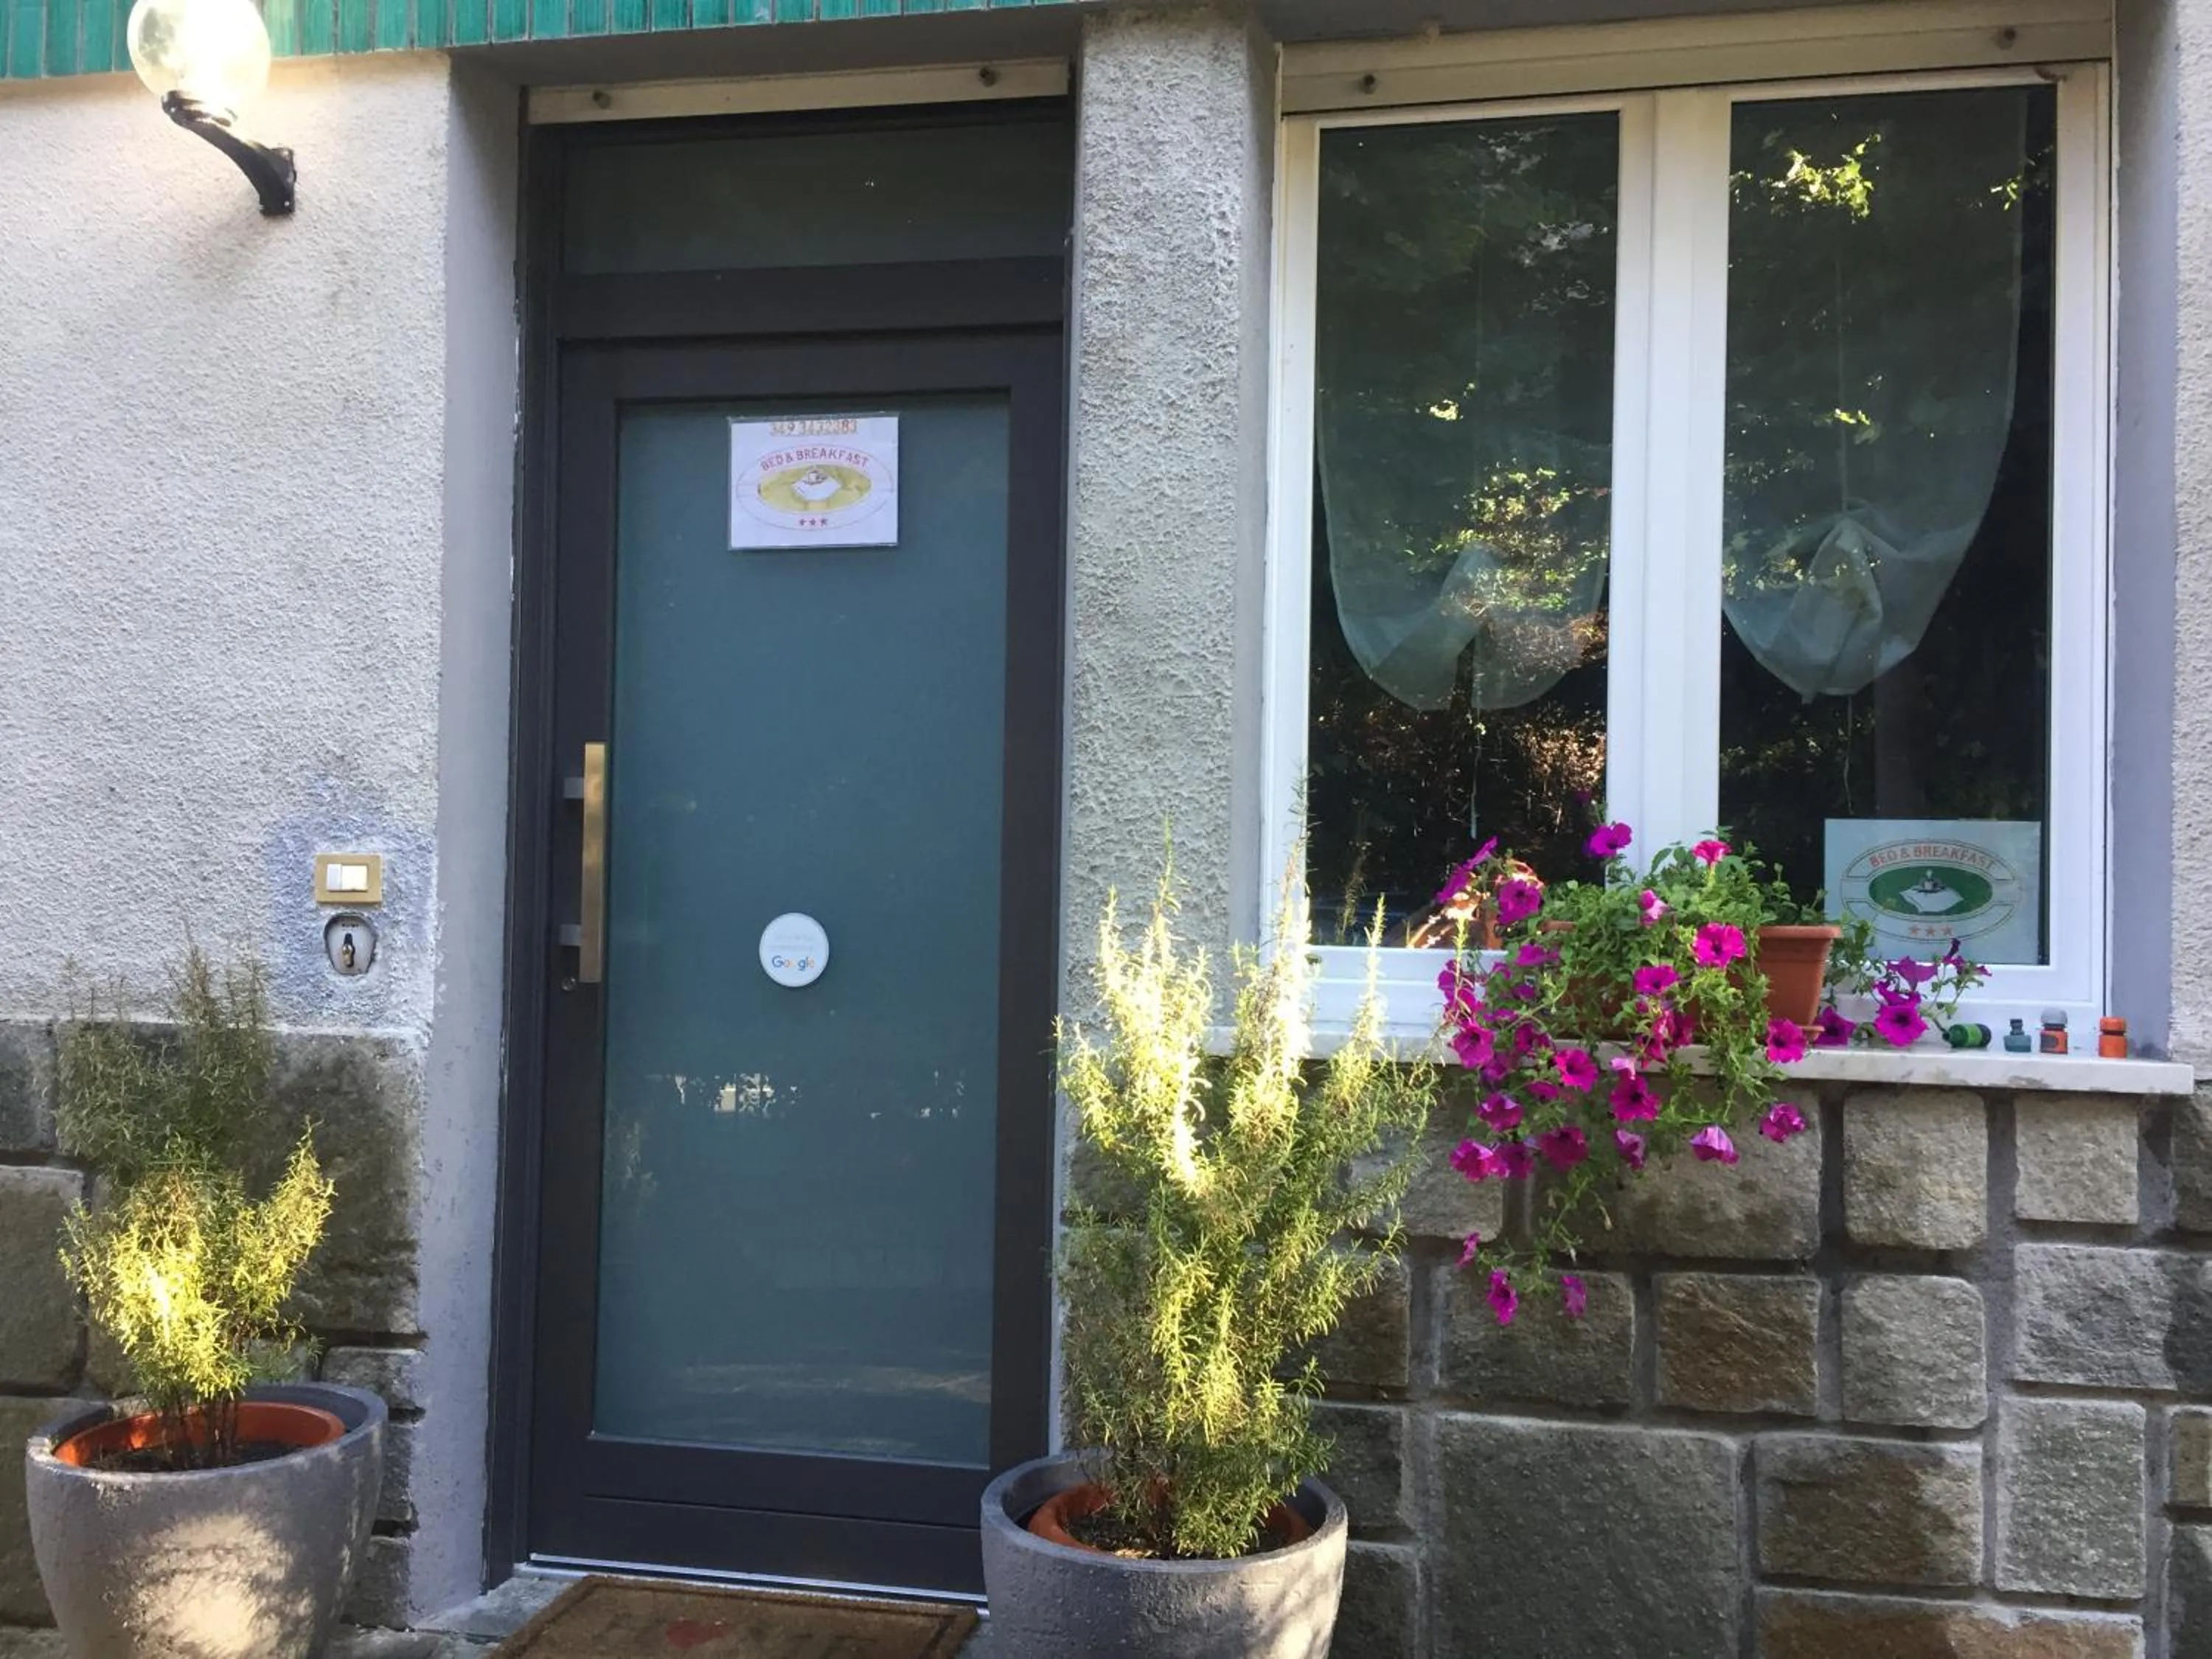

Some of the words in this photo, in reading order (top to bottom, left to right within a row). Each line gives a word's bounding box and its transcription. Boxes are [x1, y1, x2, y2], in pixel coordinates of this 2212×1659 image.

[761, 455, 784, 471] BED
[796, 448, 869, 467] BREAKFAST
[1870, 849, 1897, 867] BED
[1913, 846, 1997, 869] BREAKFAST
